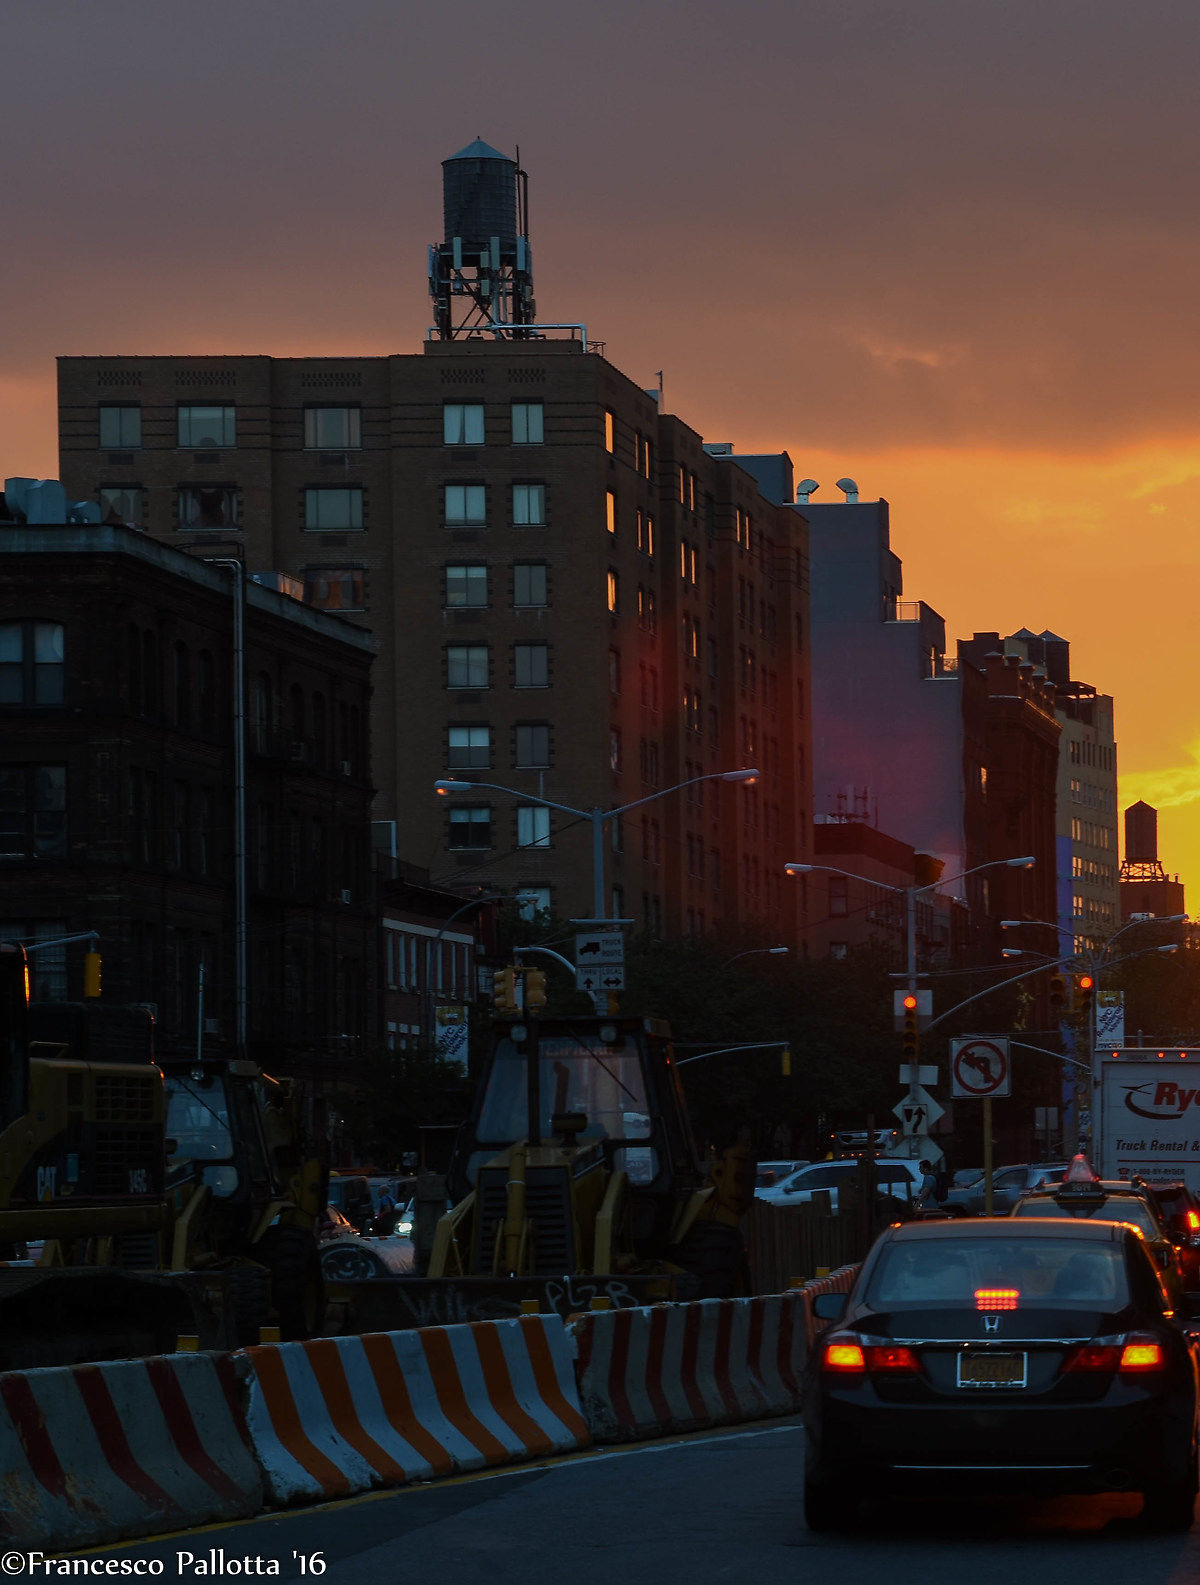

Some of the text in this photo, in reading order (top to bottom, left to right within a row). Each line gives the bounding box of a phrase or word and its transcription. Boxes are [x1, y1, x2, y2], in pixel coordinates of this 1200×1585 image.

[438, 1026, 455, 1045] NYC
[448, 1034, 468, 1055] Week
[1115, 1139, 1146, 1151] Truck
[1150, 1139, 1187, 1151] Rental
[1191, 1140, 1200, 1152] &
[37, 1166, 57, 1201] CAT
